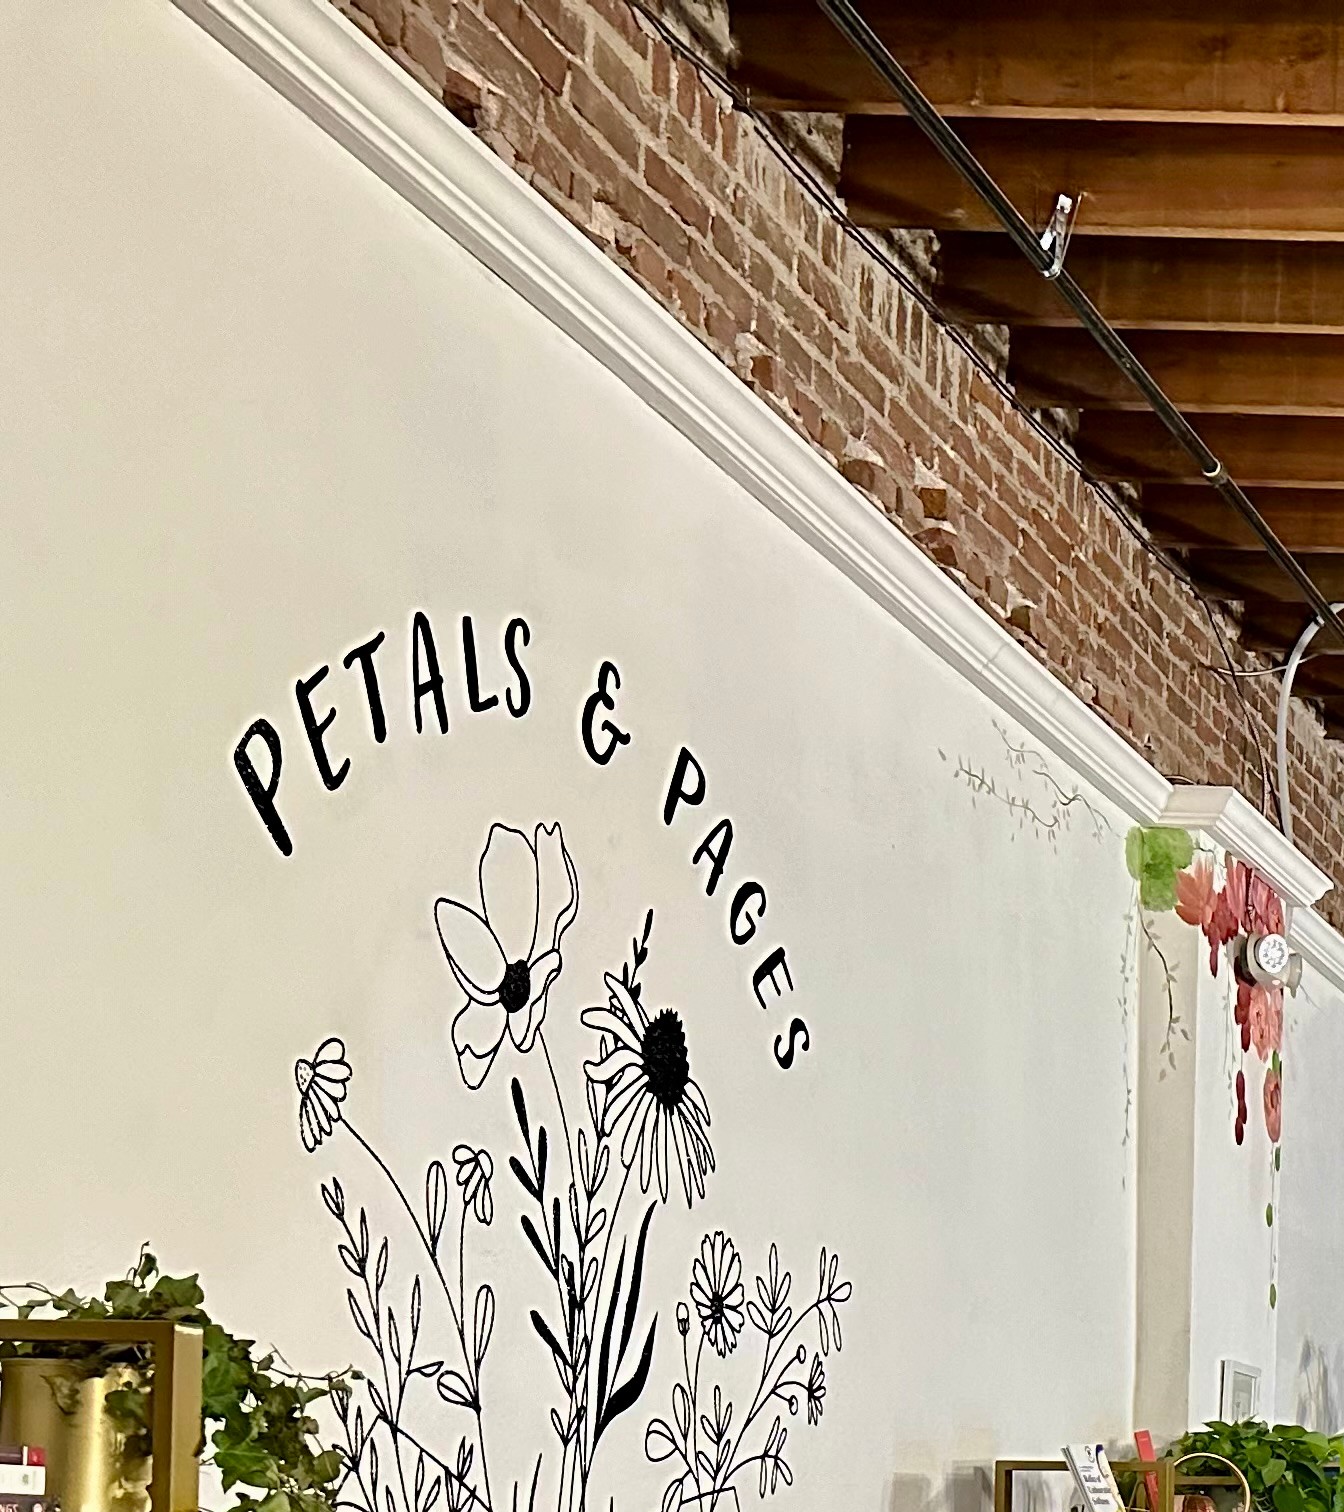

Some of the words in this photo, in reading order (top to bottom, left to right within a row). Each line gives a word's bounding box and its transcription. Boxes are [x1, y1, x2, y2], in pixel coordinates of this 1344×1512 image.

[234, 611, 531, 857] PETALS
[582, 661, 631, 764] &
[663, 747, 811, 1070] PAGES
